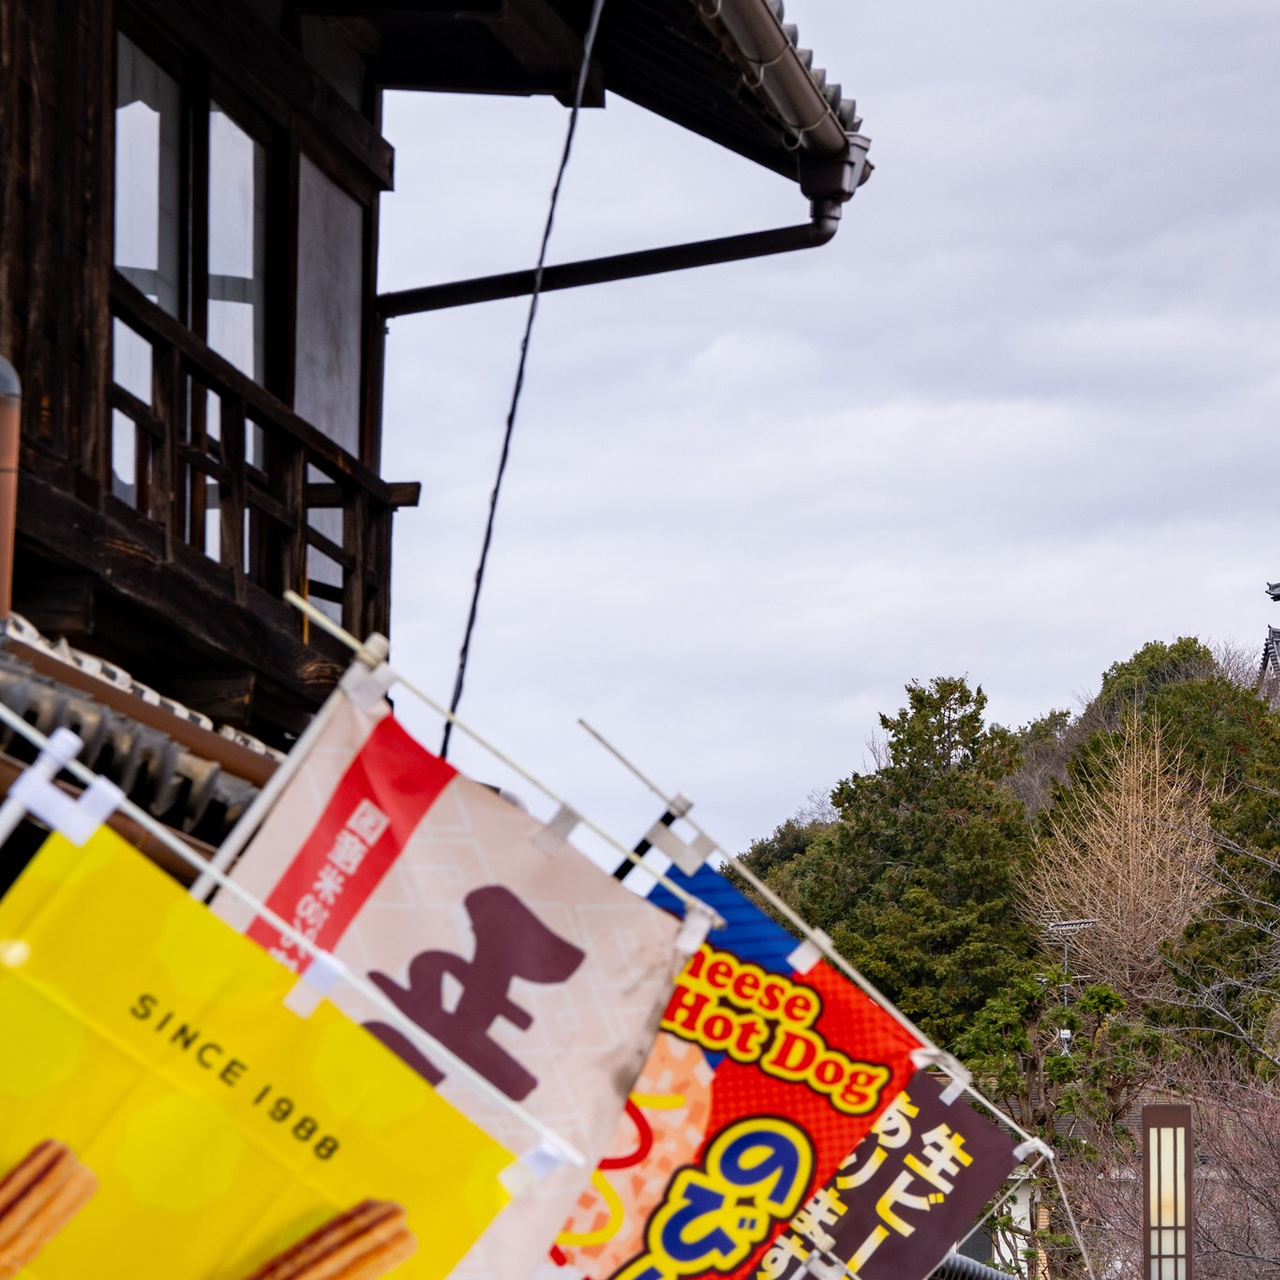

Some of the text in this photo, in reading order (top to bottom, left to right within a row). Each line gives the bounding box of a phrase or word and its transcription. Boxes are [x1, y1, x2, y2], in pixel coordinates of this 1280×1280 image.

[663, 986, 879, 1104] Hot Dog
[687, 950, 811, 1022] eese
[129, 994, 340, 1161] SINCE 1988
